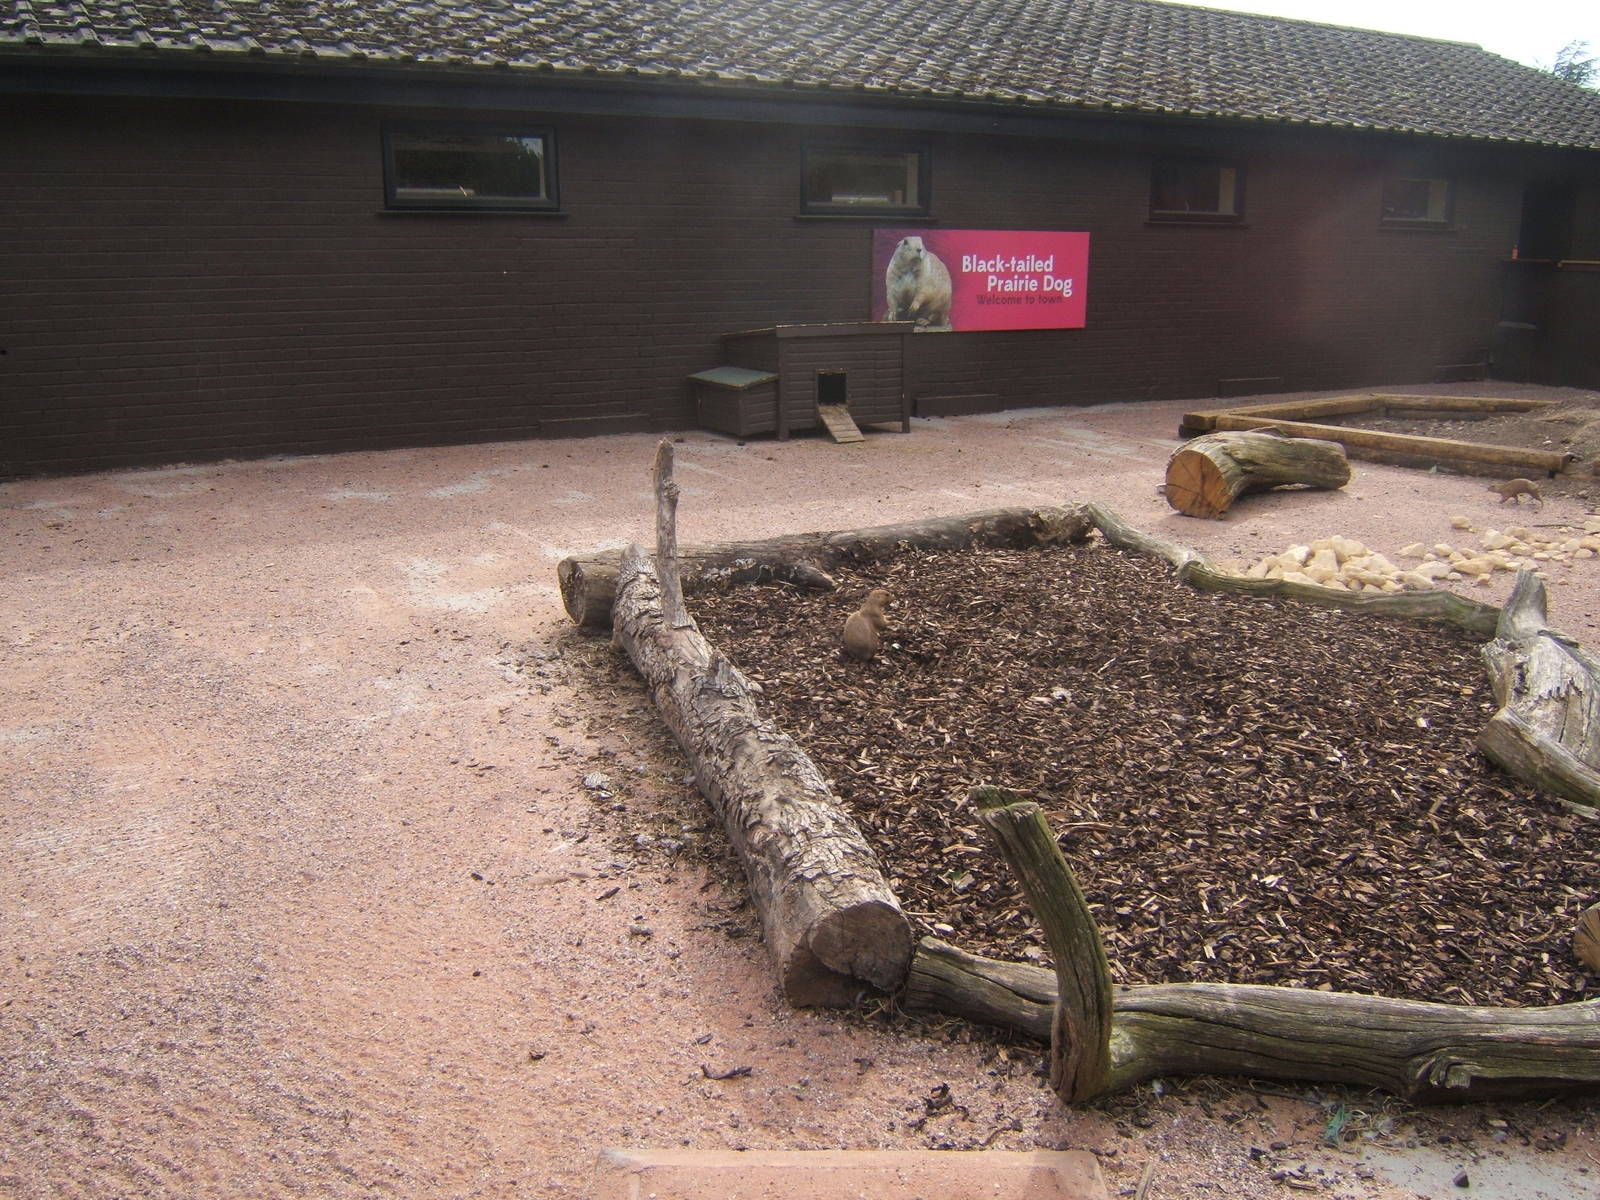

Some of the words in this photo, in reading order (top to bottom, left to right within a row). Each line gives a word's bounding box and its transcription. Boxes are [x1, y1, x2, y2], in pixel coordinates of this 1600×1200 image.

[962, 254, 1054, 273] Black-tailed
[987, 274, 1038, 292] Prairie
[1043, 274, 1073, 298] Dog
[976, 294, 1022, 305] Welcome
[1025, 294, 1036, 305] to
[1038, 294, 1063, 305] town
